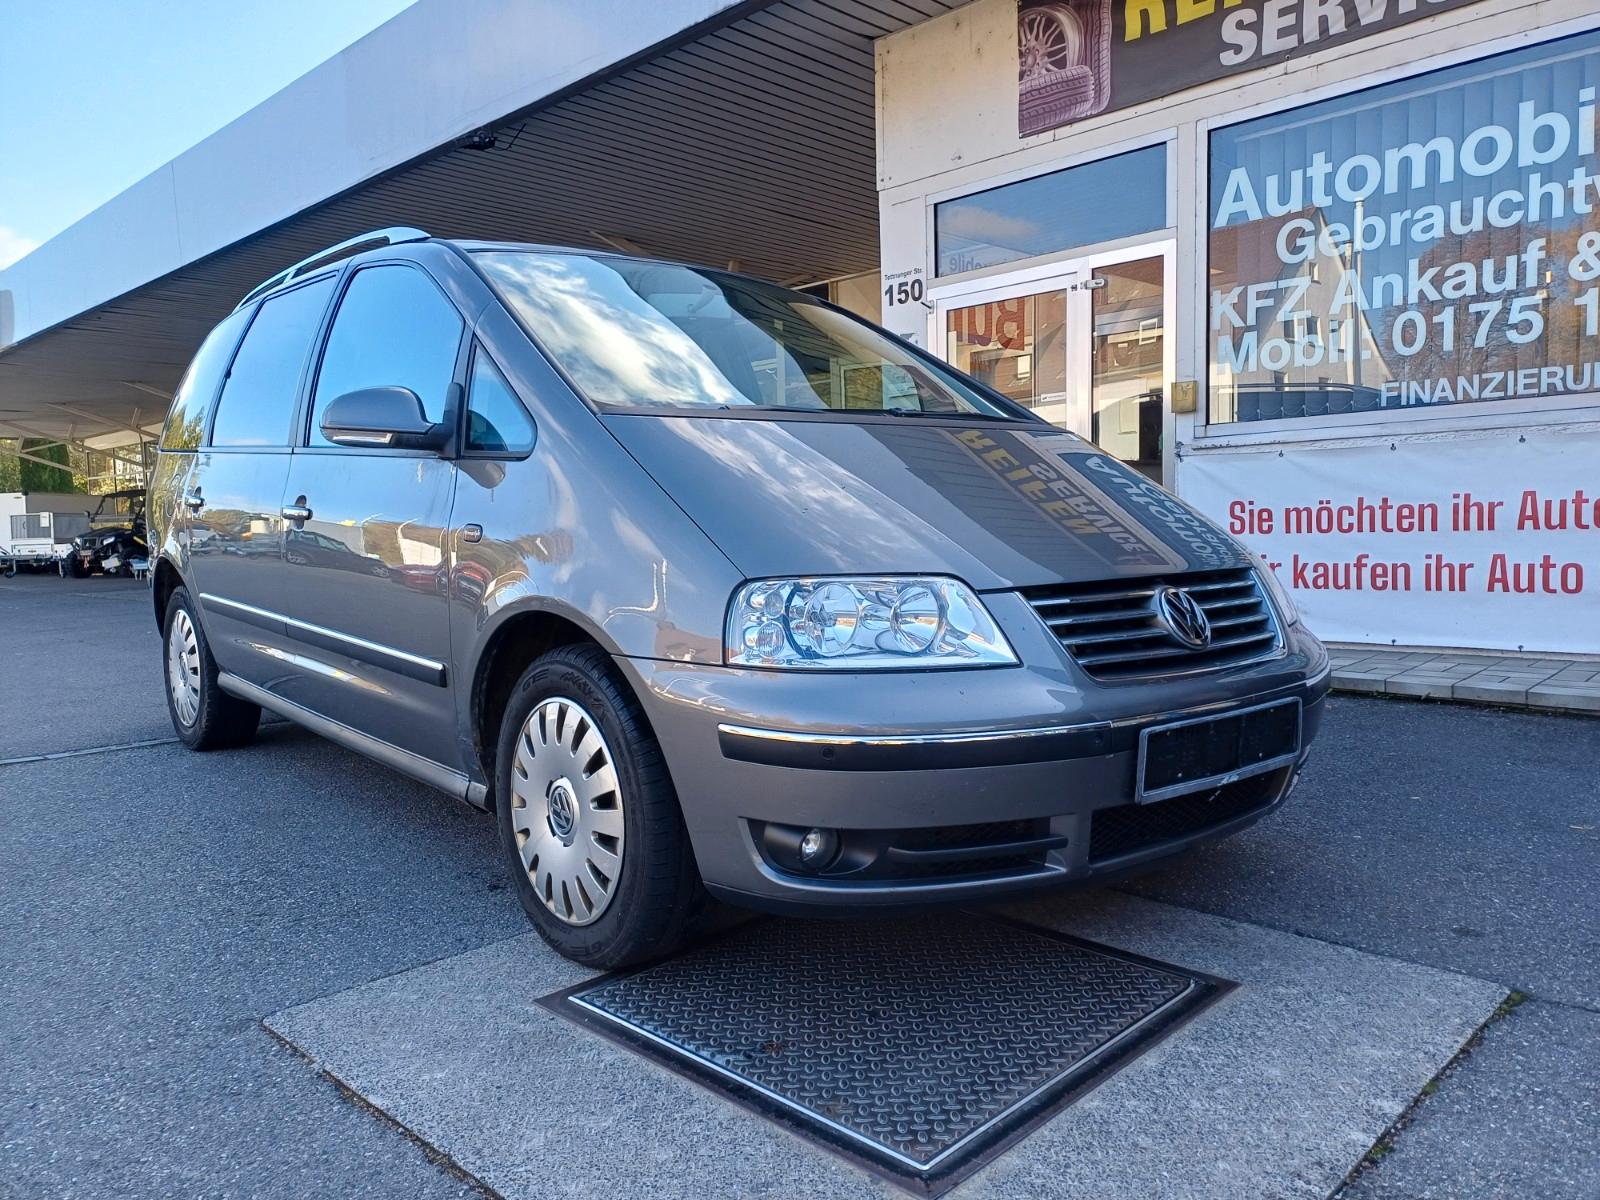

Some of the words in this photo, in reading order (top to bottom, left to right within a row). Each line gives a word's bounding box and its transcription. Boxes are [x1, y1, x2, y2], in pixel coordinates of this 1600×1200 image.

[1219, 0, 1449, 66] SERV
[884, 278, 924, 307] 150
[1211, 275, 1312, 330] KFZ
[1331, 237, 1547, 314] Ankauf
[1392, 295, 1545, 357] 0175
[1574, 287, 1599, 336] 1
[1229, 499, 1274, 535] Sie
[1284, 496, 1439, 534] möchten
[1452, 492, 1504, 531] ihr
[1517, 490, 1600, 531] Aut
[1293, 553, 1411, 591] kaufen
[1424, 553, 1474, 592] ihr
[1487, 554, 1584, 594] Auto
